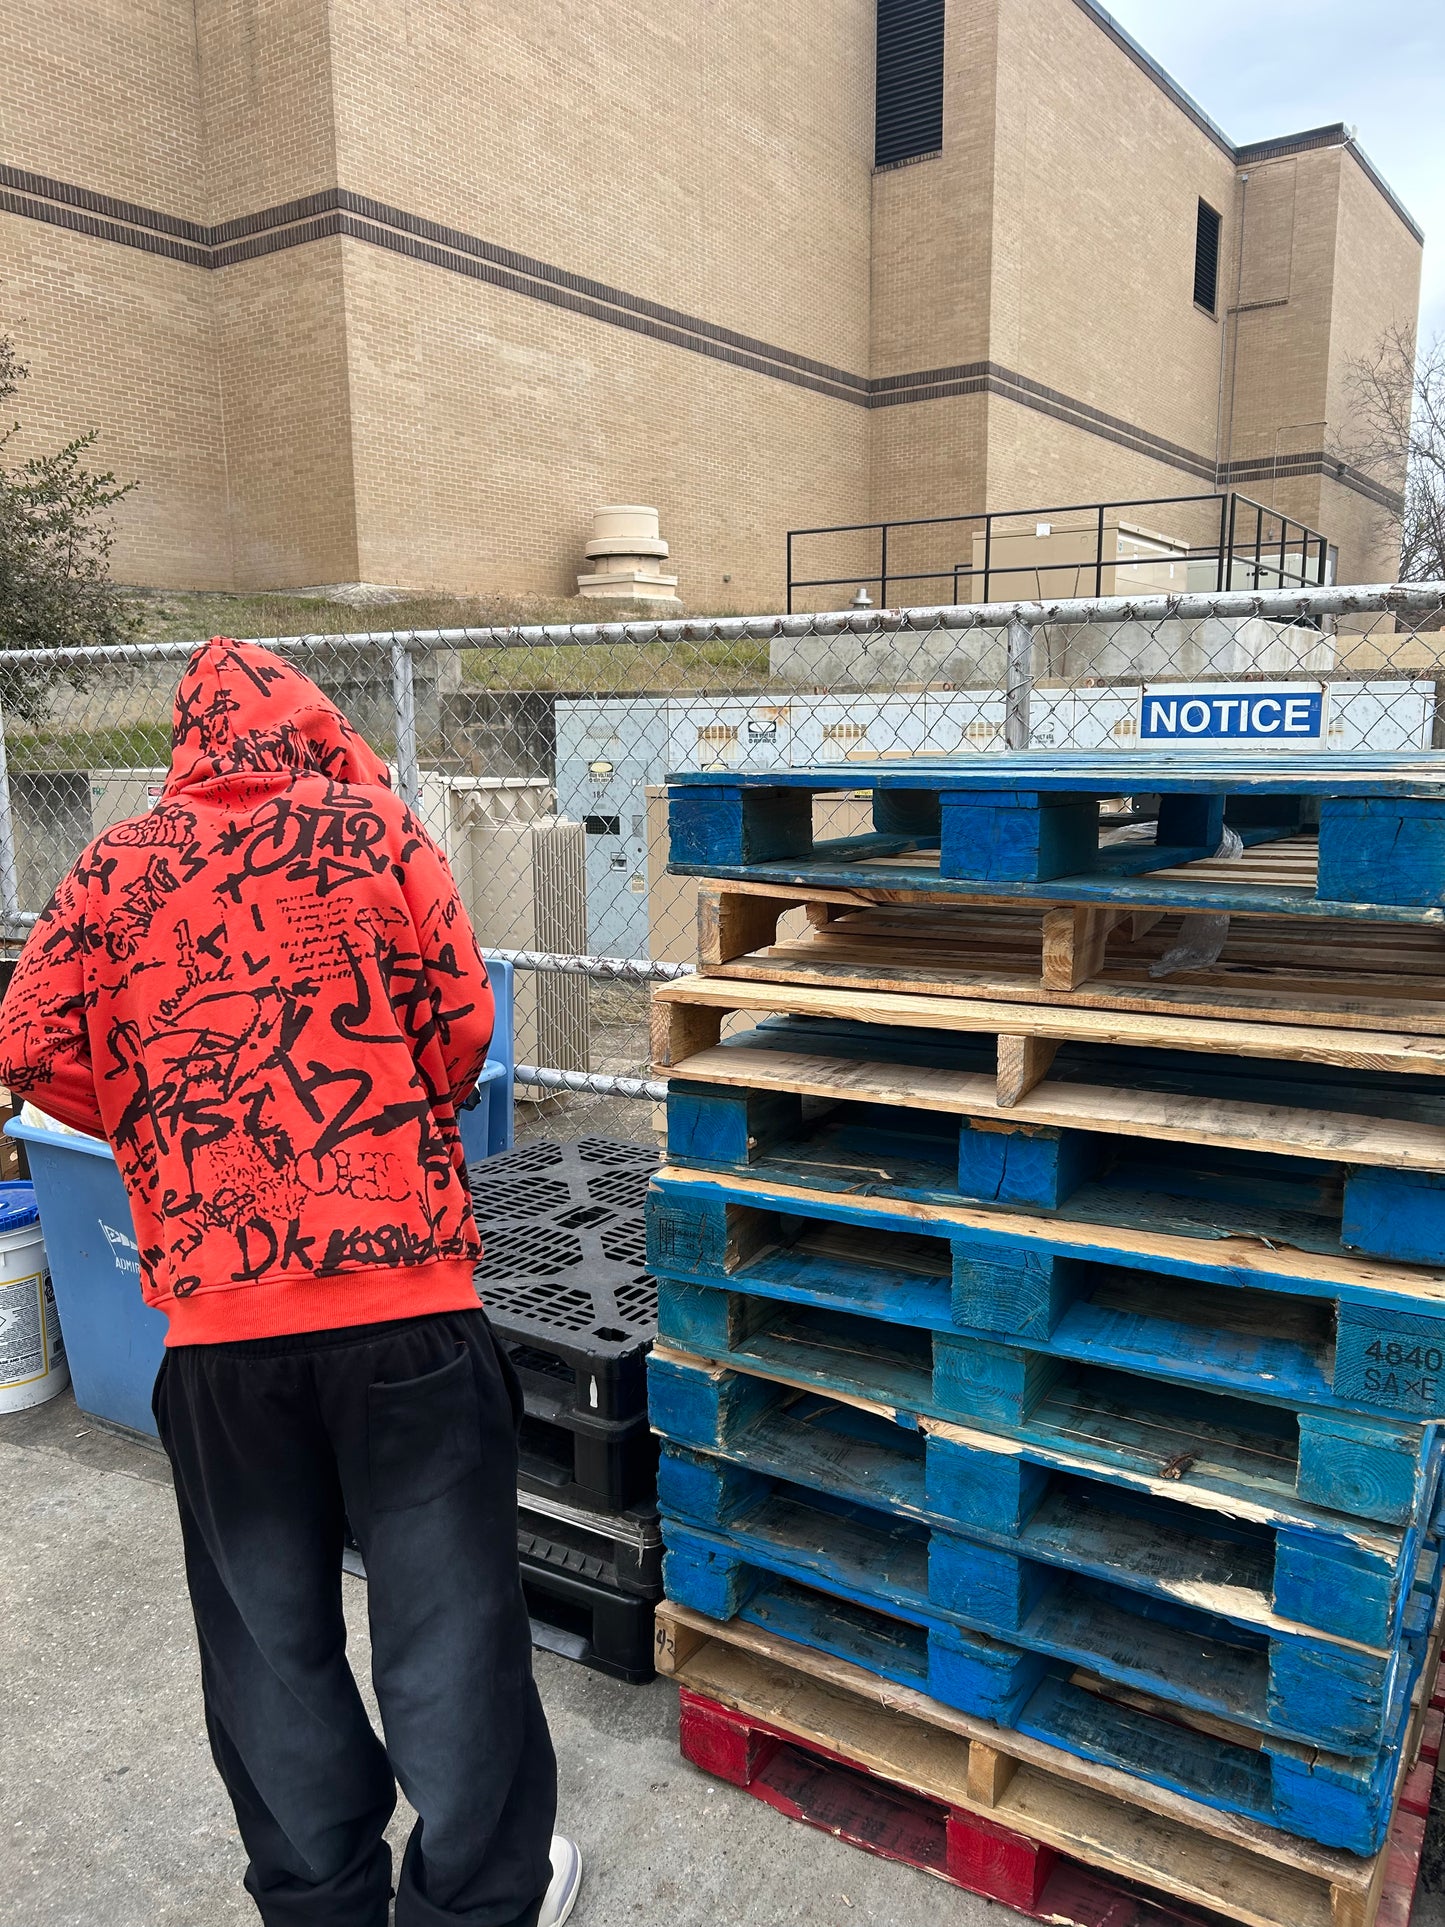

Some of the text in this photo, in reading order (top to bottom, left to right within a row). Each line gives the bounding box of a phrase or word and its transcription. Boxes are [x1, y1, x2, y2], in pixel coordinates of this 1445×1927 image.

[1149, 698, 1311, 734] NOTICE
[115, 1256, 141, 1274] ADMIR
[1364, 1340, 1443, 1372] 4840
